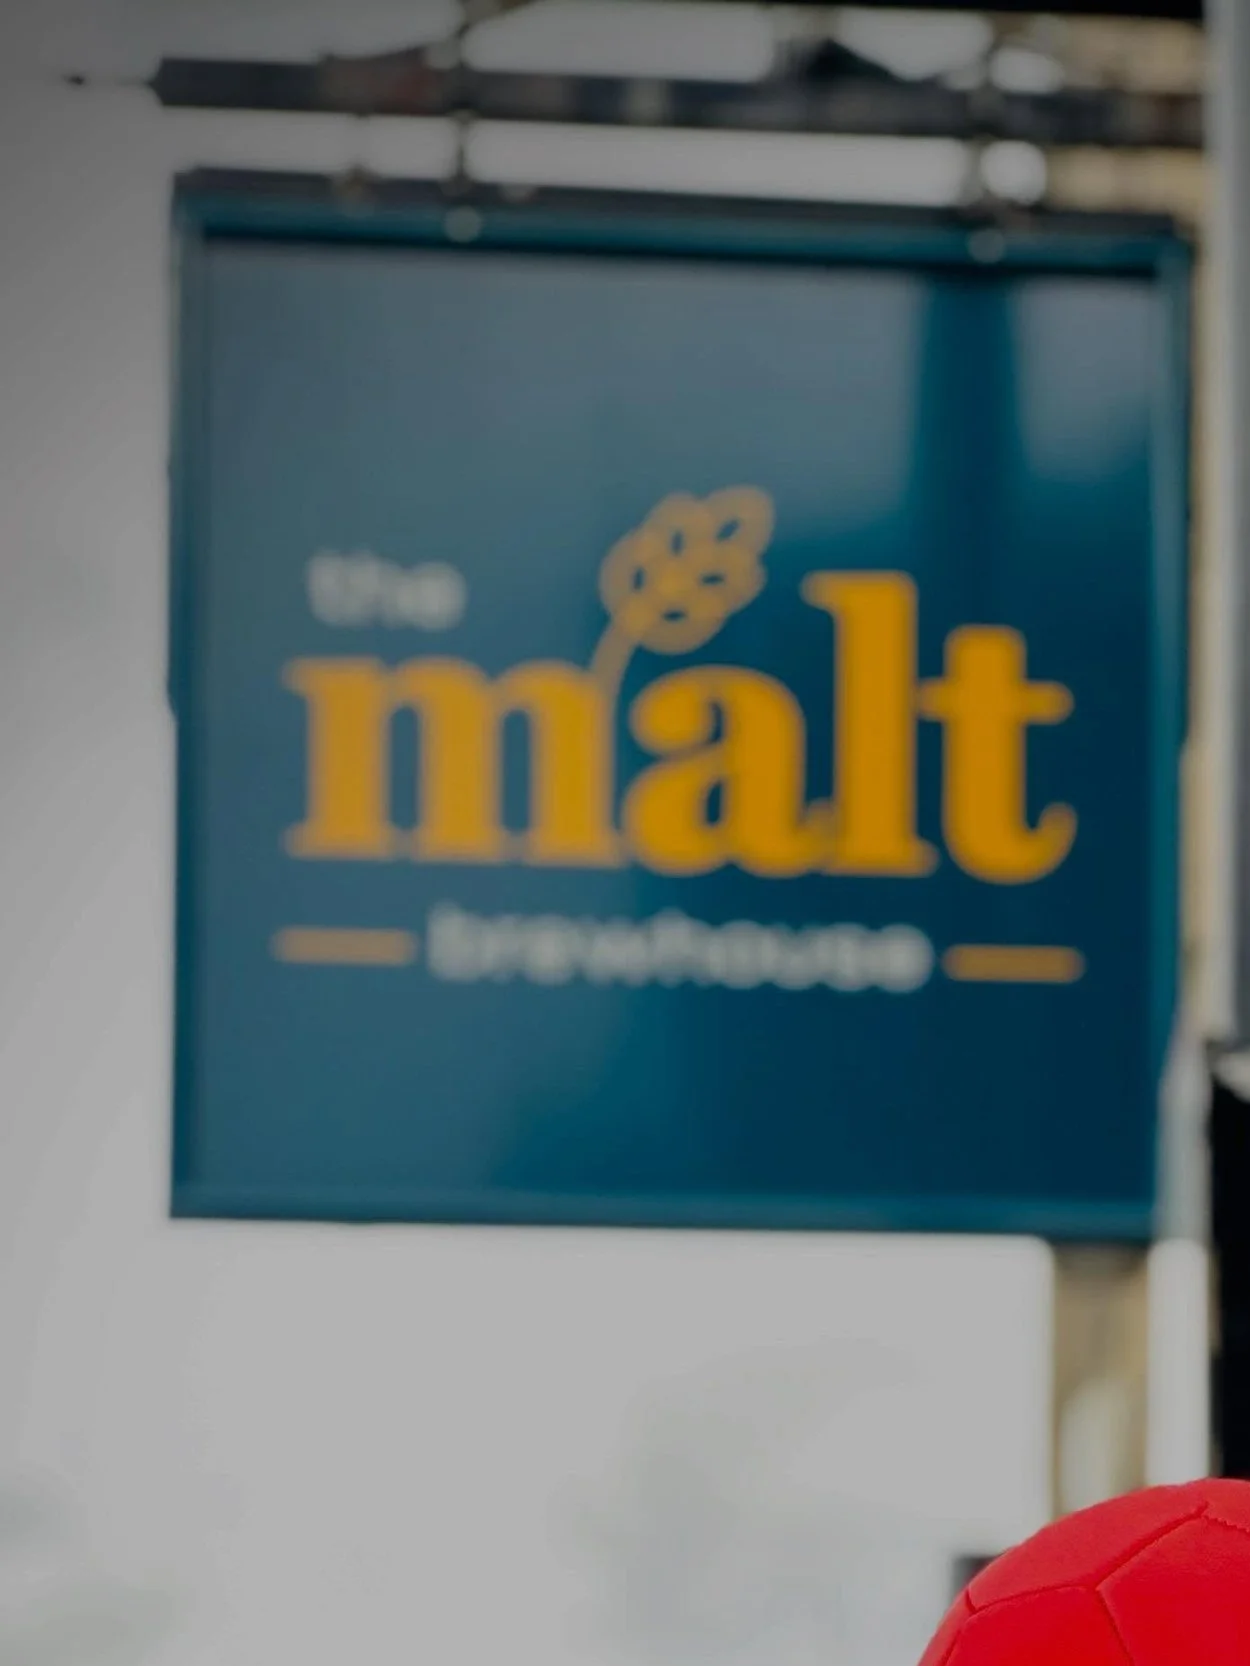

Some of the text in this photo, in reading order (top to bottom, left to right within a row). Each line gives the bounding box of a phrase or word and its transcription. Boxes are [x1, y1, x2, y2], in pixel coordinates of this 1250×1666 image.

[308, 550, 465, 630] the
[283, 570, 1077, 883] malt
[427, 904, 932, 991] brewhouse
